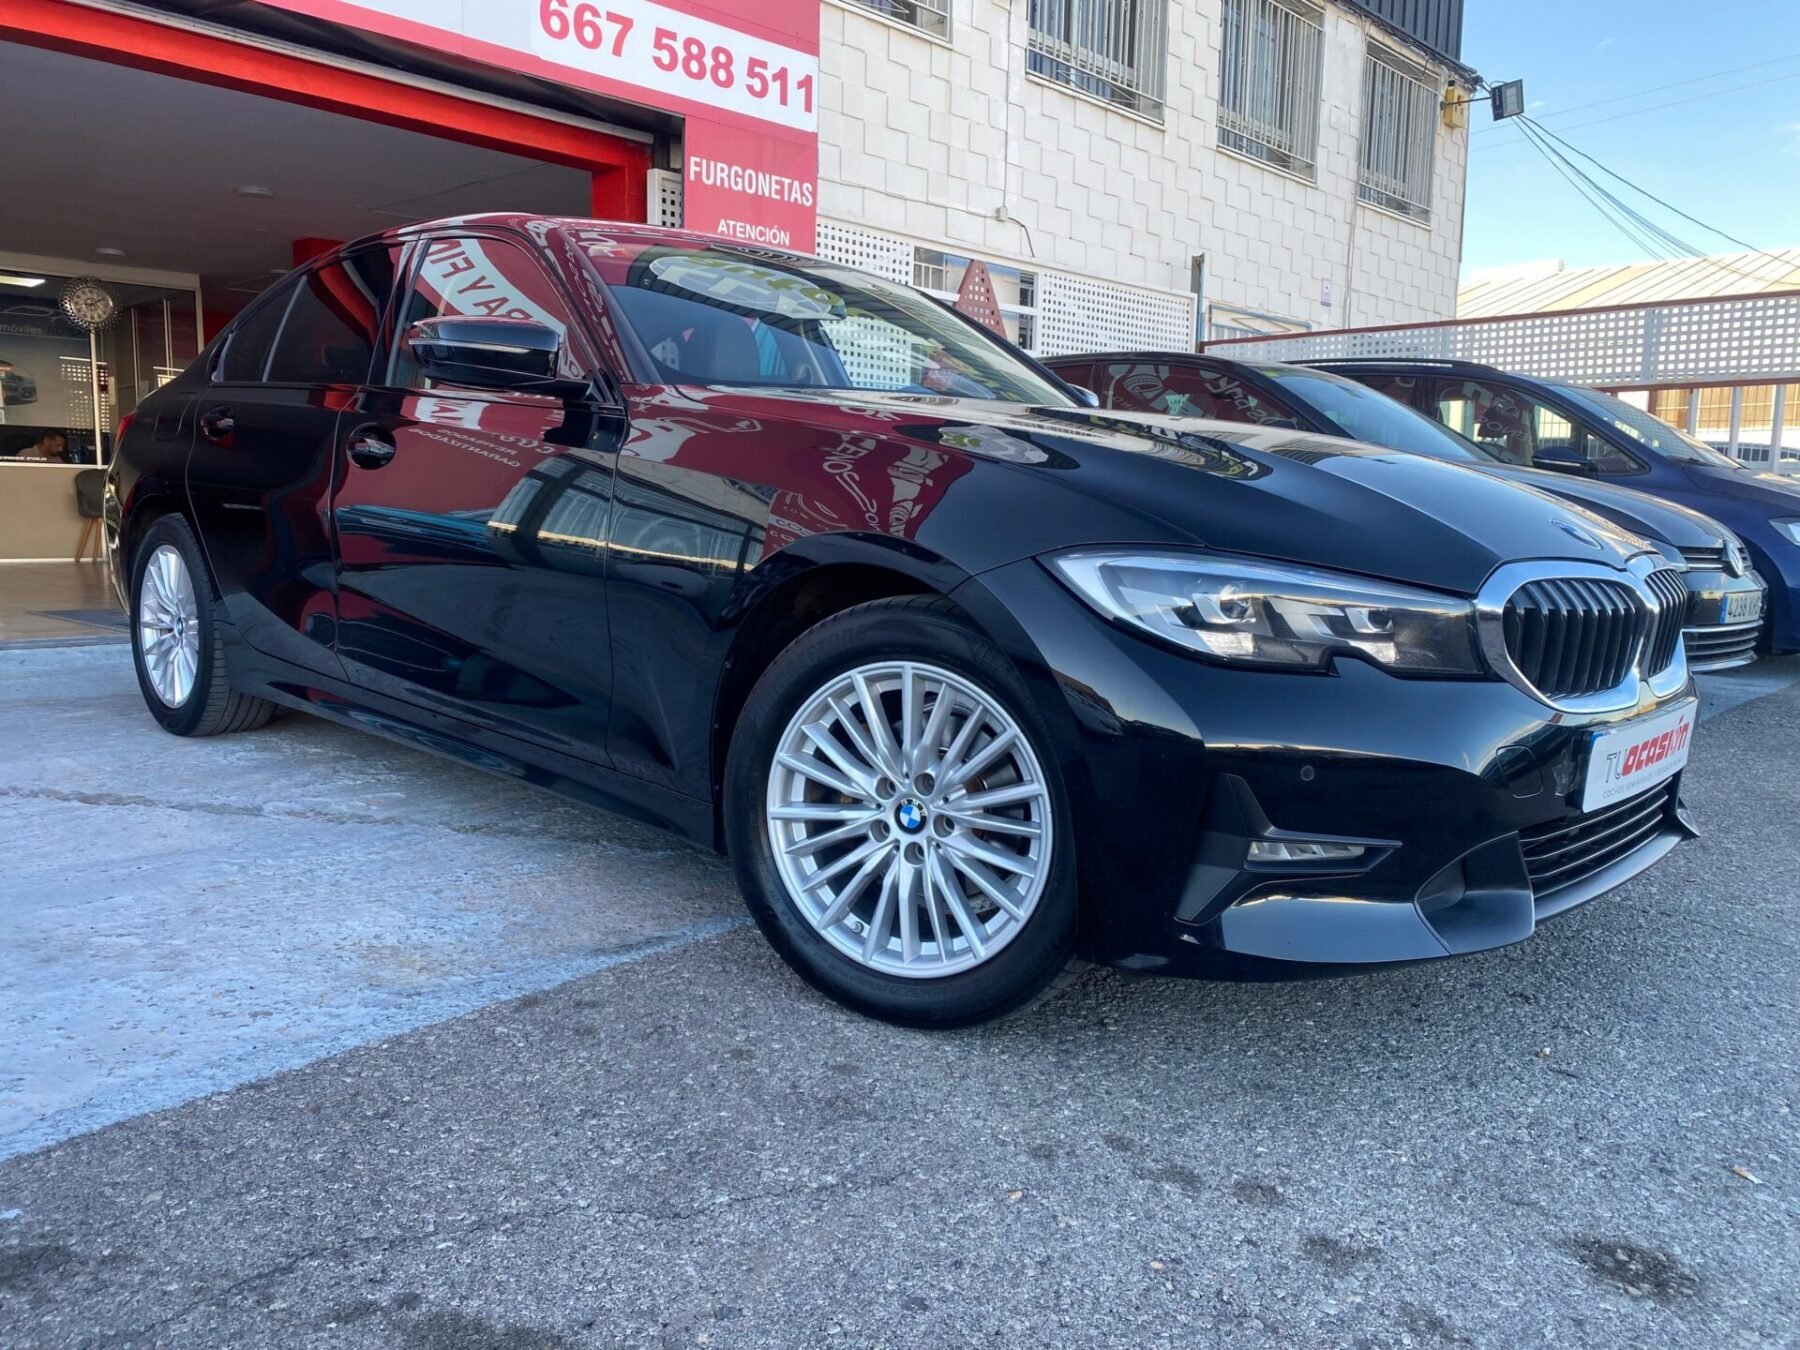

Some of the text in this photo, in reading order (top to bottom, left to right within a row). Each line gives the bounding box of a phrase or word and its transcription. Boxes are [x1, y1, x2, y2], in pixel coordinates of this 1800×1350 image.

[540, 0, 812, 113] 667 588 511
[689, 156, 812, 206] FURGONETAS
[718, 219, 790, 246] ATENCIÓN
